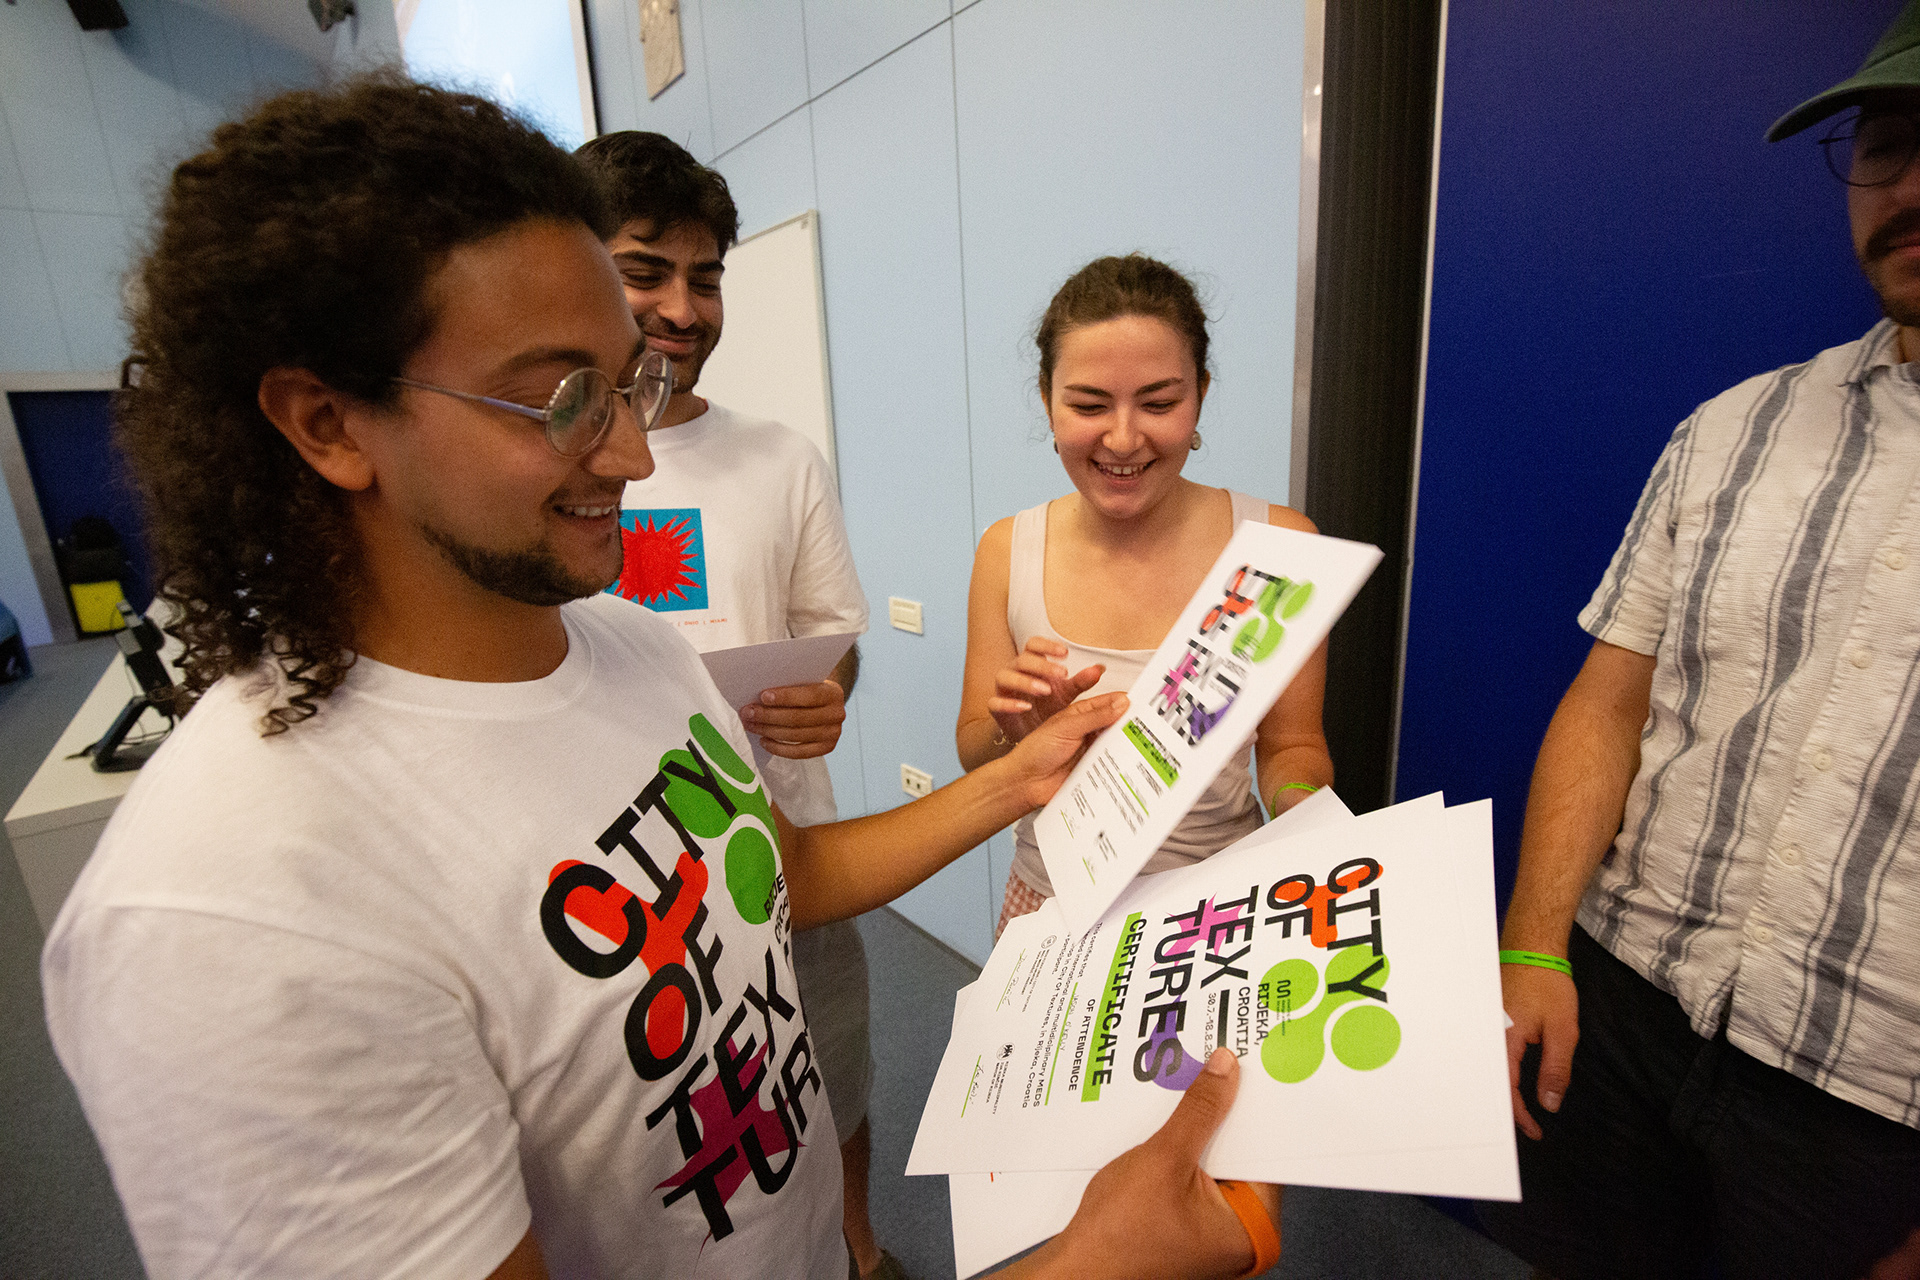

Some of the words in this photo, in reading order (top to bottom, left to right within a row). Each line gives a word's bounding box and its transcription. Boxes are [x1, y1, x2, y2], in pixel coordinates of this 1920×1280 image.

[540, 739, 737, 979] CITY
[1264, 873, 1316, 939] OF
[1200, 884, 1259, 989] TEX
[1327, 857, 1388, 1003] CITY
[624, 900, 724, 1082] OF
[1086, 999, 1096, 1012] OF
[1092, 918, 1147, 1086] CERTIFICATE
[1132, 898, 1207, 1083] TURES
[1236, 986, 1251, 1058] CROATIA
[1253, 982, 1270, 1046] RIJEKA,
[645, 945, 796, 1161] TEX
[1022, 1072, 1036, 1108] Croatia
[1033, 1079, 1045, 1107] MEDS
[1068, 1015, 1092, 1091] ATTENDENCE
[661, 1002, 821, 1243] TUR
